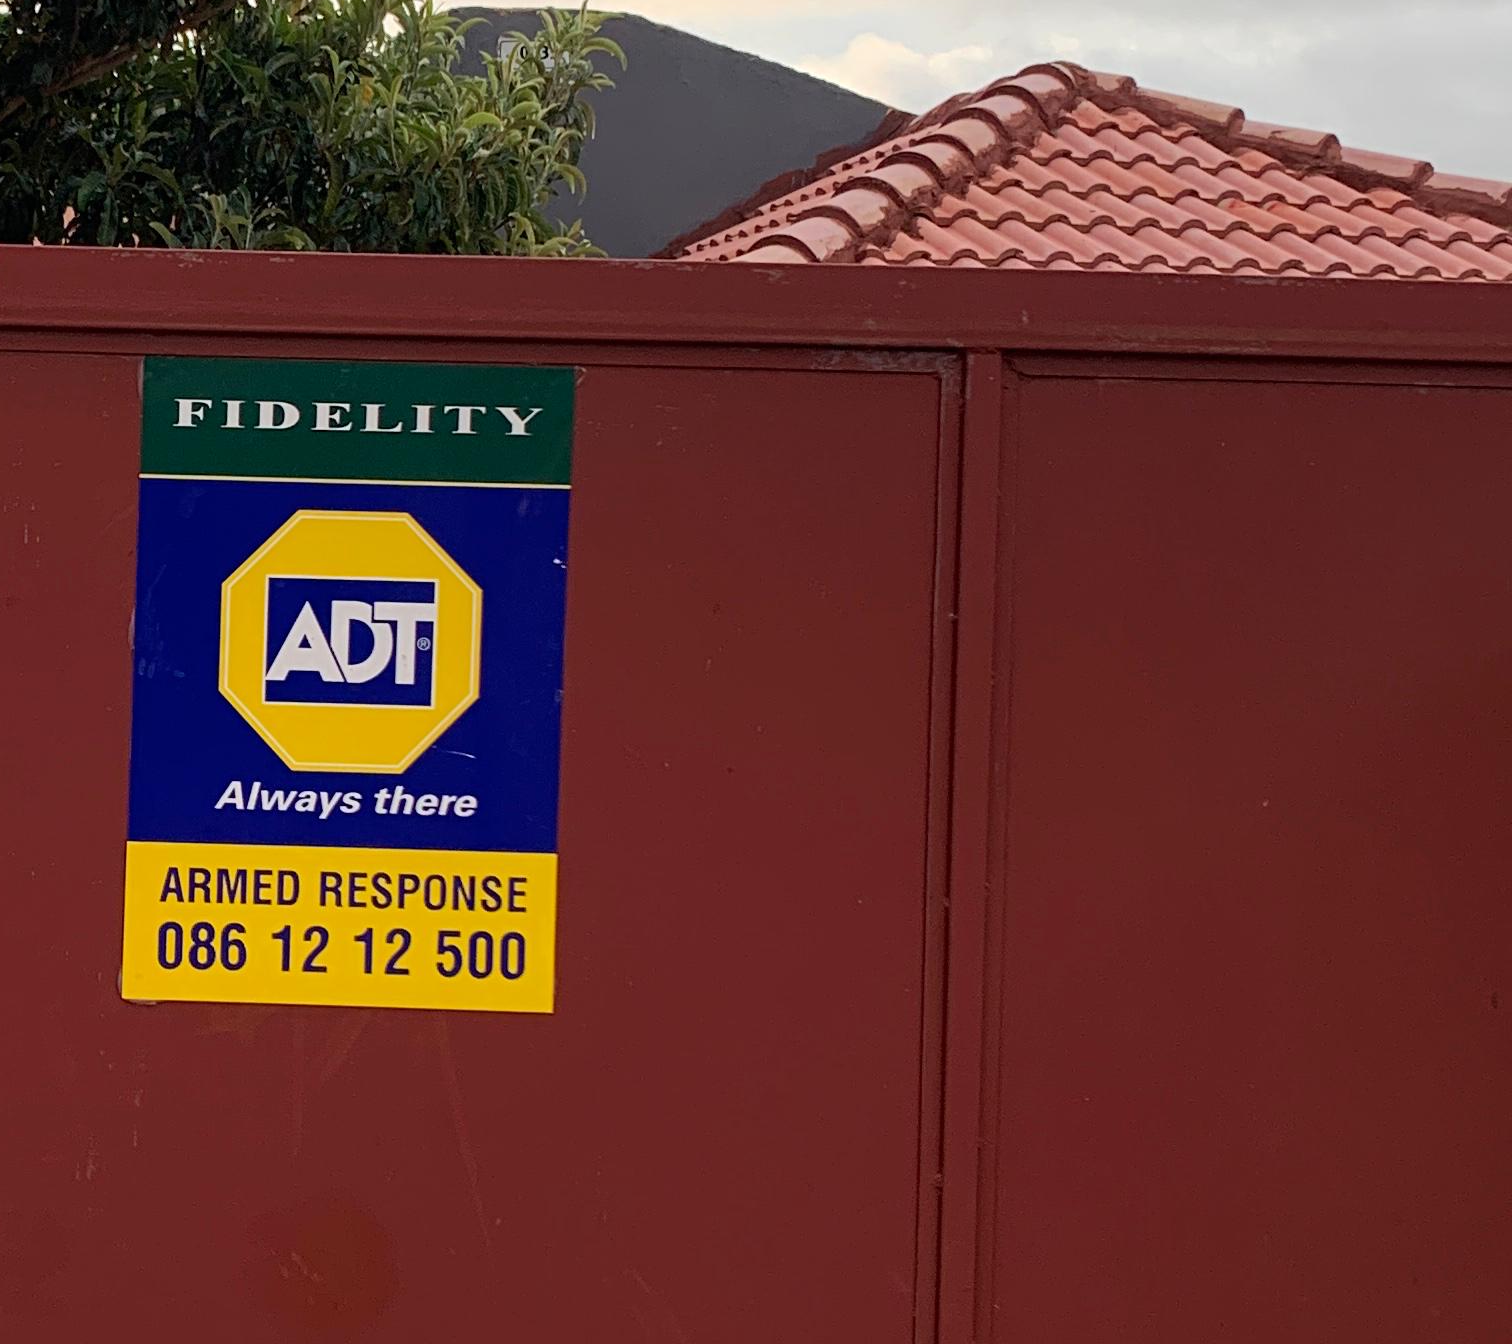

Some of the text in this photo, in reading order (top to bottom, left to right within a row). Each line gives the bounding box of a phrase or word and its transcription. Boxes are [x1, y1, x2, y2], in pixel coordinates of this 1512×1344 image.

[172, 397, 544, 437] FIDELITY
[265, 600, 436, 685] ADT
[215, 780, 478, 819] Always there
[159, 866, 528, 913] ARMED RESPONSE
[157, 921, 527, 980] 086 12 12 500
